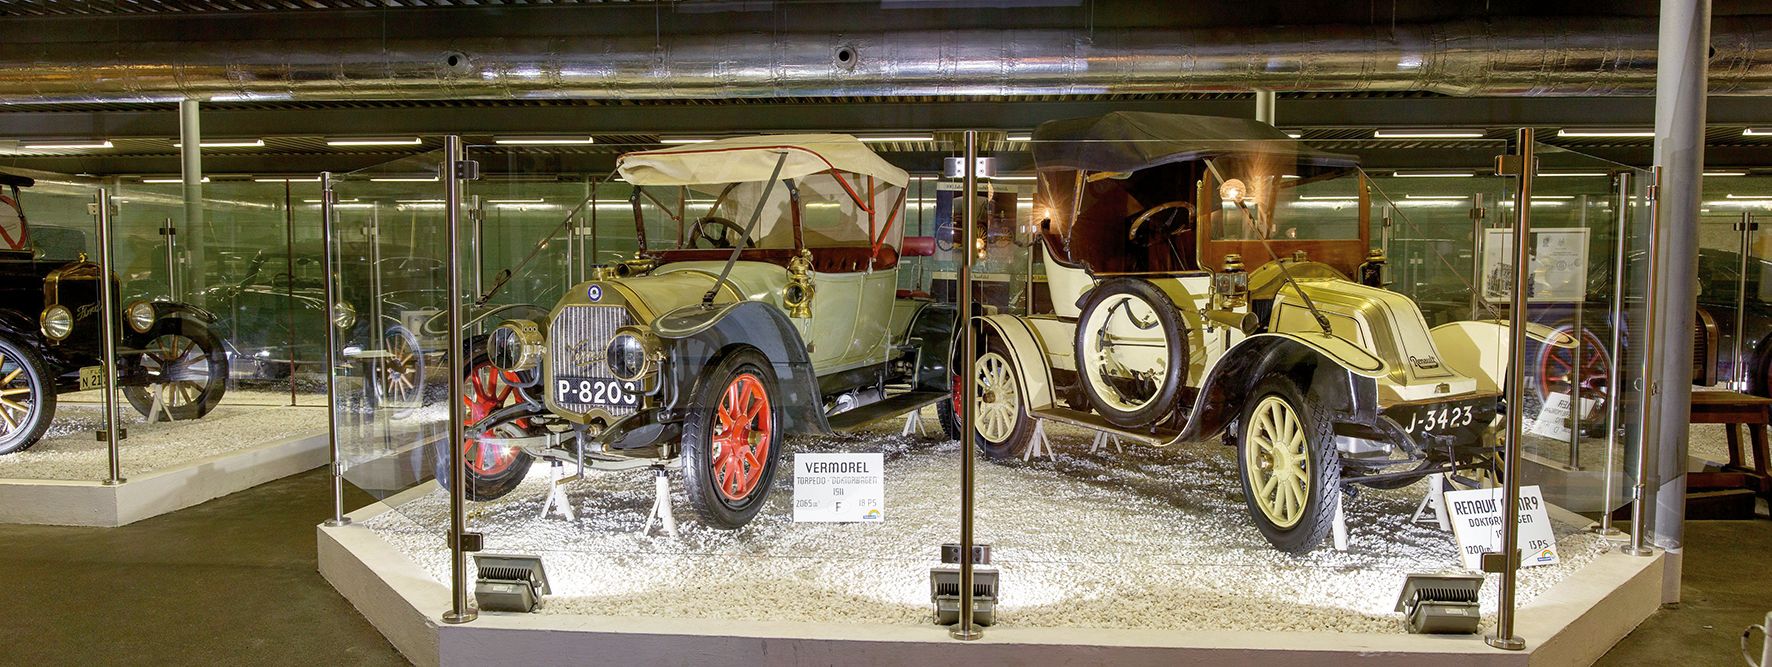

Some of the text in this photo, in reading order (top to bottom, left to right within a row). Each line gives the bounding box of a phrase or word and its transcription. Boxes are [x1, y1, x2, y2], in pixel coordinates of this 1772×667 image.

[558, 379, 635, 404] P-8203
[1405, 405, 1473, 434] J-3423
[805, 461, 869, 474] VERMOREL
[797, 476, 826, 485] TORPEDO
[835, 501, 842, 512] F
[1454, 498, 1497, 515] RENAULT
